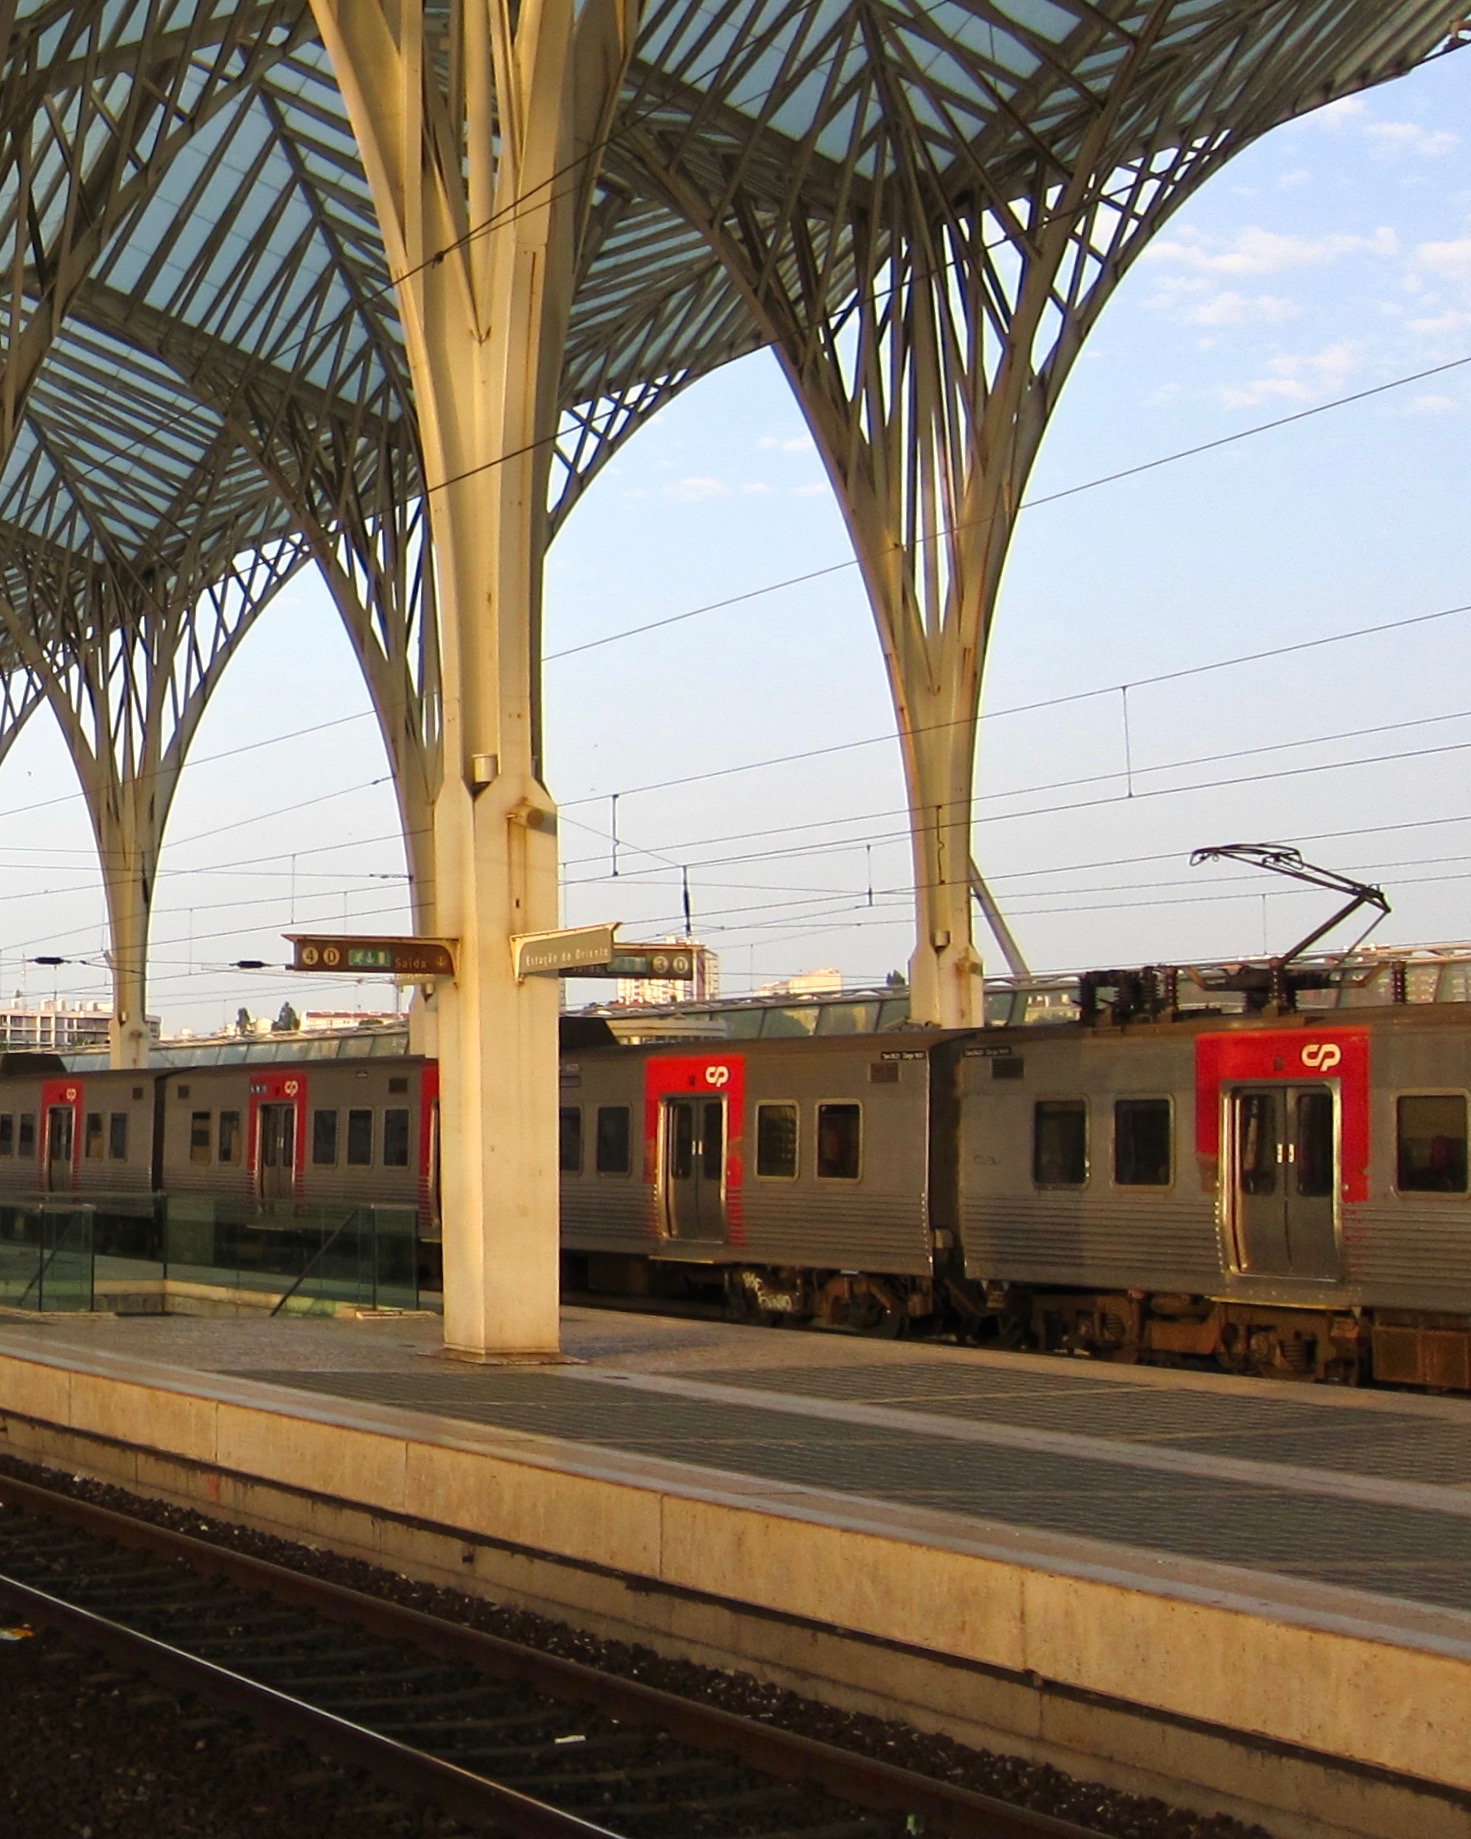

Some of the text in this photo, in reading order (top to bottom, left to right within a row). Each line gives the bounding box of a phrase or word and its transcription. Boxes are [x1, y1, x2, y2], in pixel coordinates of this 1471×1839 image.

[525, 948, 608, 967] Estação de Oriente
